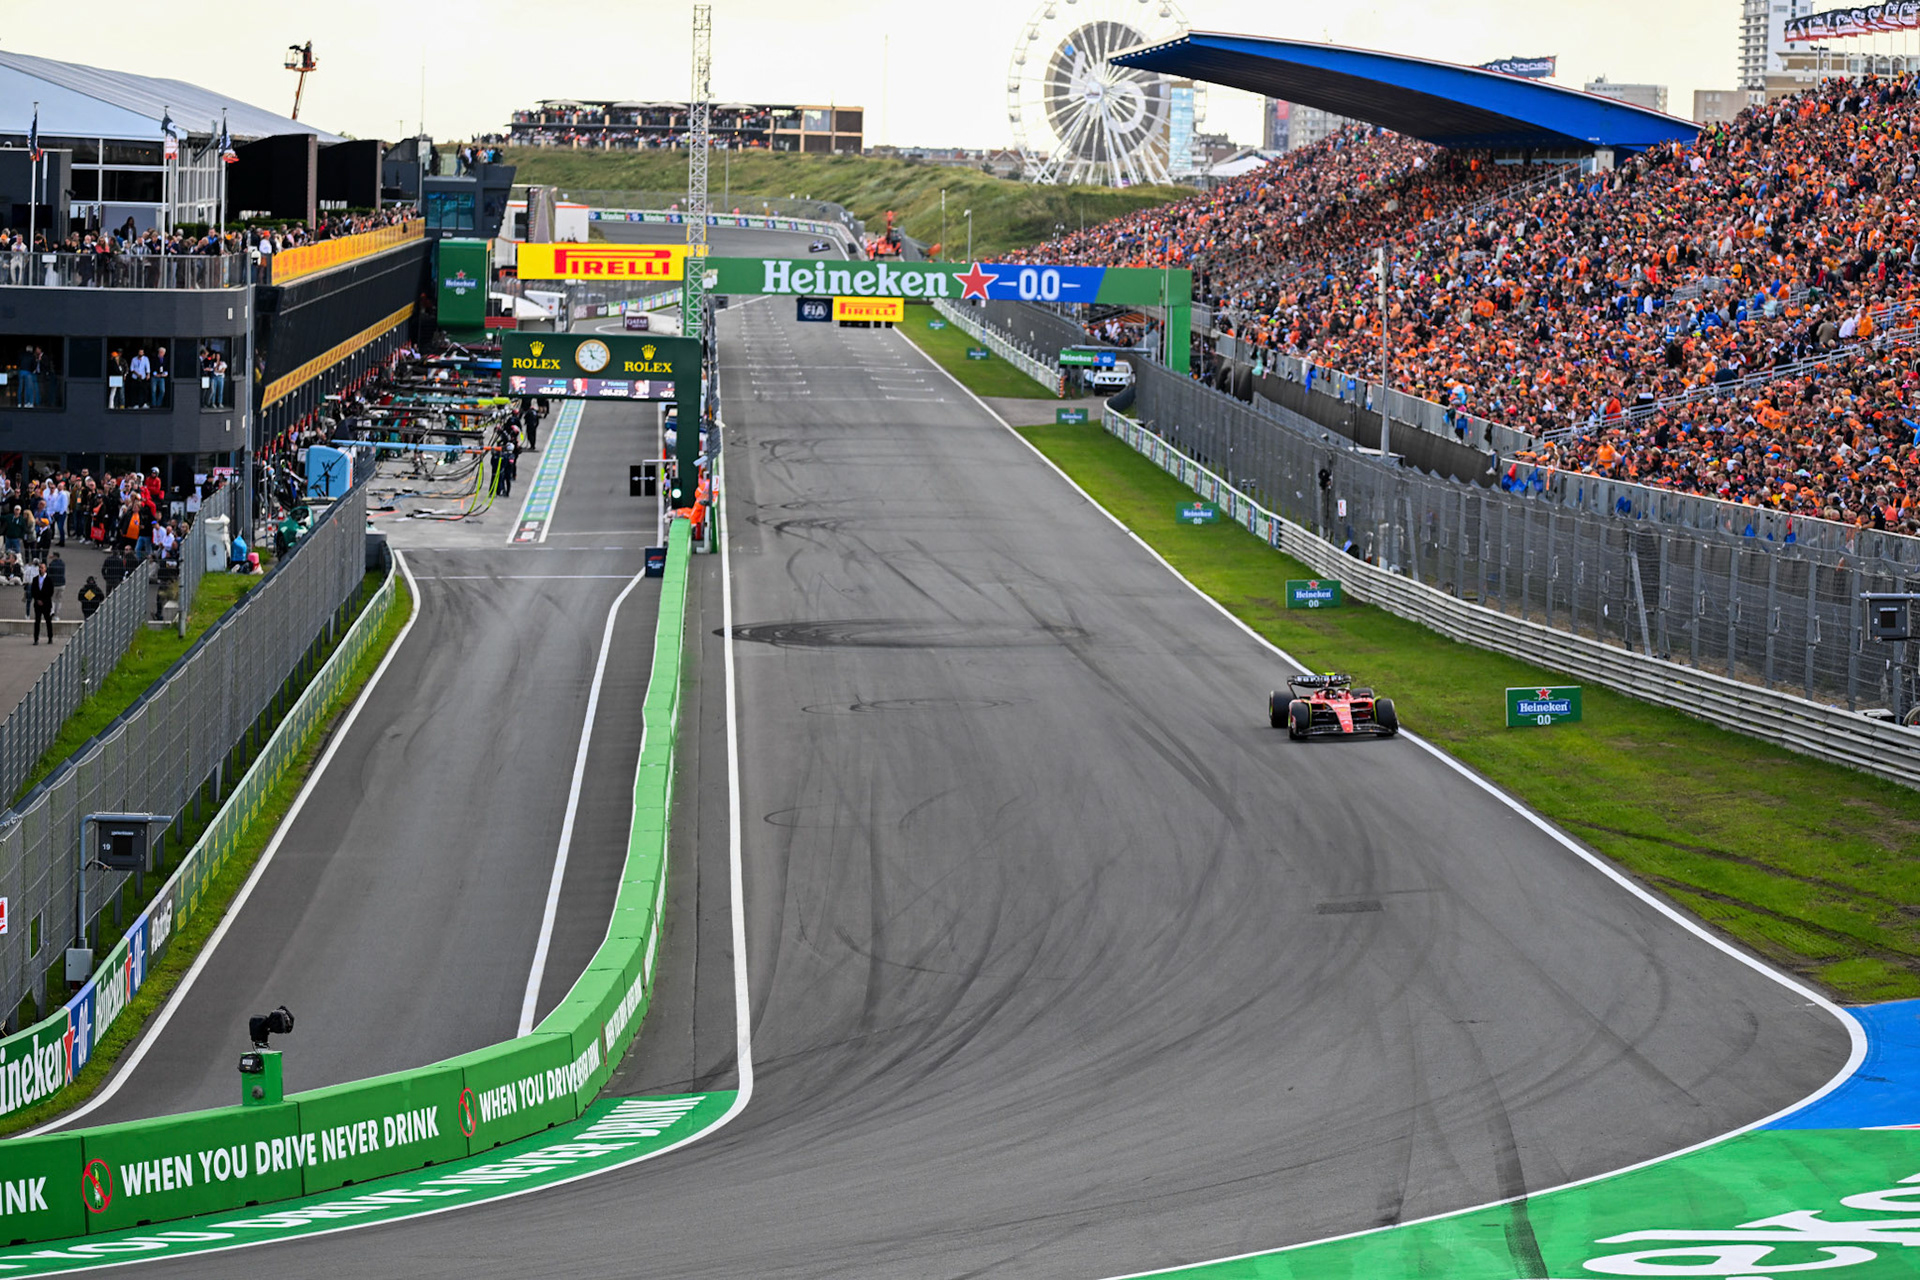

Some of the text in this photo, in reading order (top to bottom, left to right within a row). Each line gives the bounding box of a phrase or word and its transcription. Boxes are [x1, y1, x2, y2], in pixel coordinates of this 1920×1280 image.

[554, 249, 671, 275] PIRELLI
[762, 260, 1060, 300] Heineken 0.0
[839, 302, 897, 315] PIRELLI
[512, 358, 561, 370] ROLEX
[624, 361, 673, 373] ROLEX
[1060, 353, 1092, 362] Heineken
[1296, 590, 1331, 599] Heineken
[1520, 701, 1568, 712] Heineken
[95, 961, 124, 1046] Heineken
[479, 1079, 517, 1122] WHEN
[520, 1071, 545, 1107] YOU
[546, 1062, 578, 1101] DRIVE
[120, 1106, 439, 1197] WHEN YOU DRIVE NEVER DRINK
[206, 1188, 472, 1228] DRIVE
